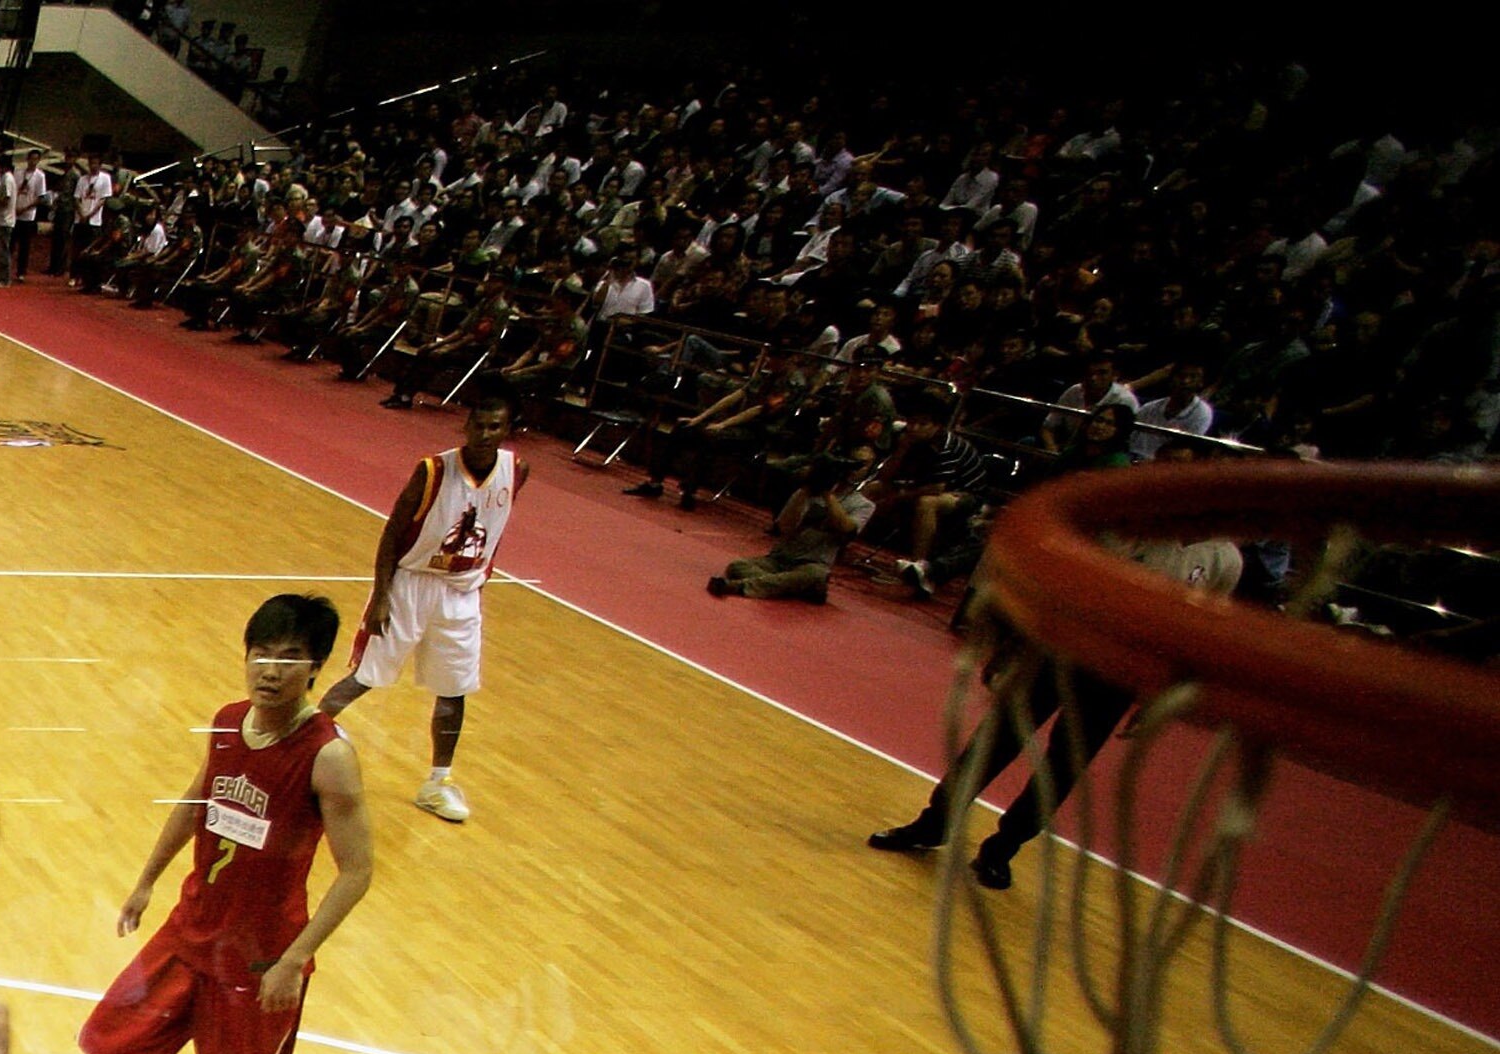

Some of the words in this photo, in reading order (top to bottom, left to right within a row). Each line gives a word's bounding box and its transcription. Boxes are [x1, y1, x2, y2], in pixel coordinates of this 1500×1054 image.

[486, 487, 509, 509] 10
[211, 774, 269, 819] CHINA
[207, 839, 237, 884] 7
